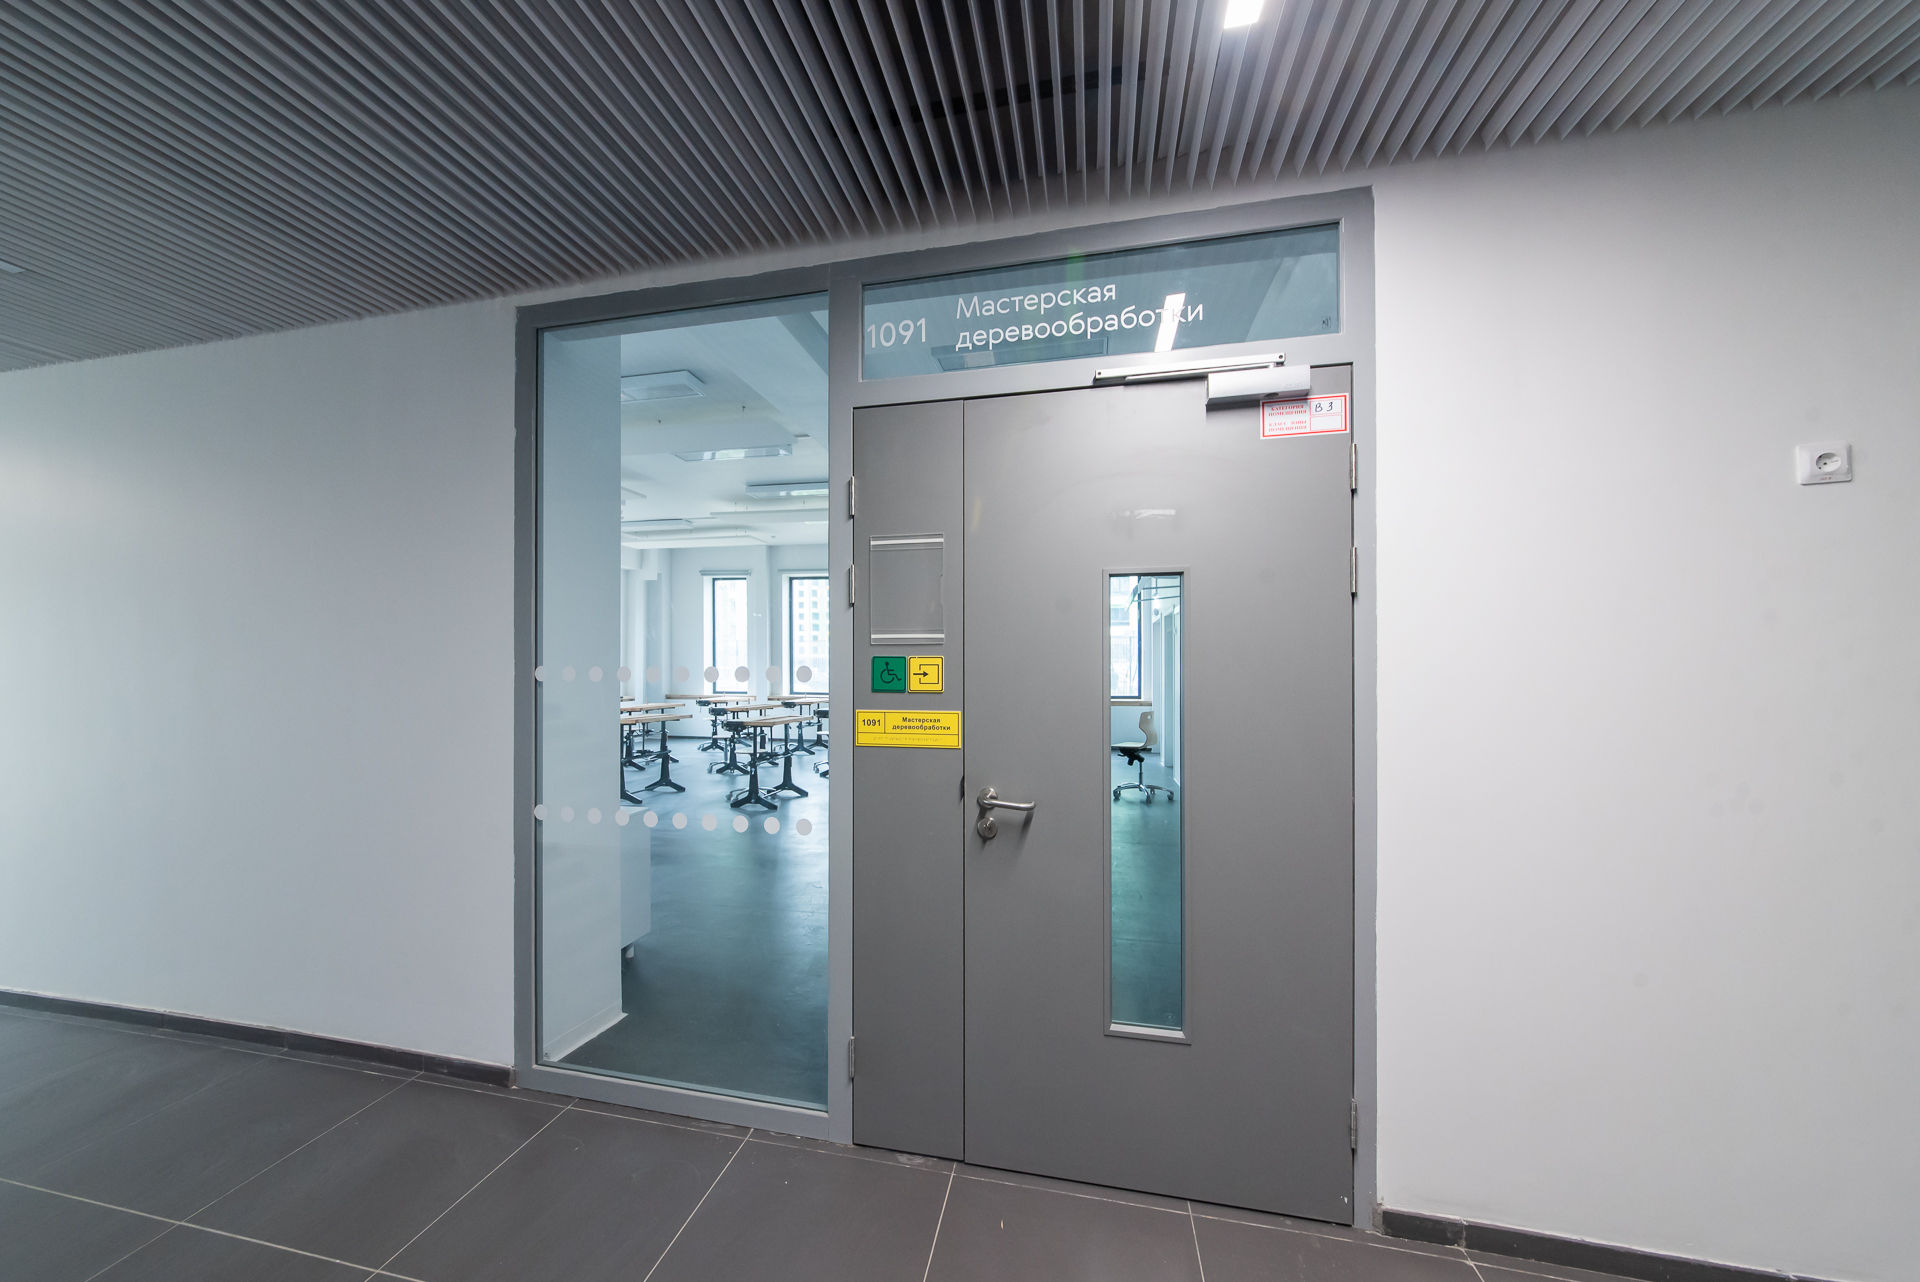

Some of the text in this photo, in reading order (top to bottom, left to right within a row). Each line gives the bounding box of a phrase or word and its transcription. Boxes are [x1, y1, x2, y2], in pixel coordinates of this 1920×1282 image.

[956, 284, 1116, 319] Мастерская
[867, 318, 927, 348] 1091
[862, 719, 881, 727] 1091
